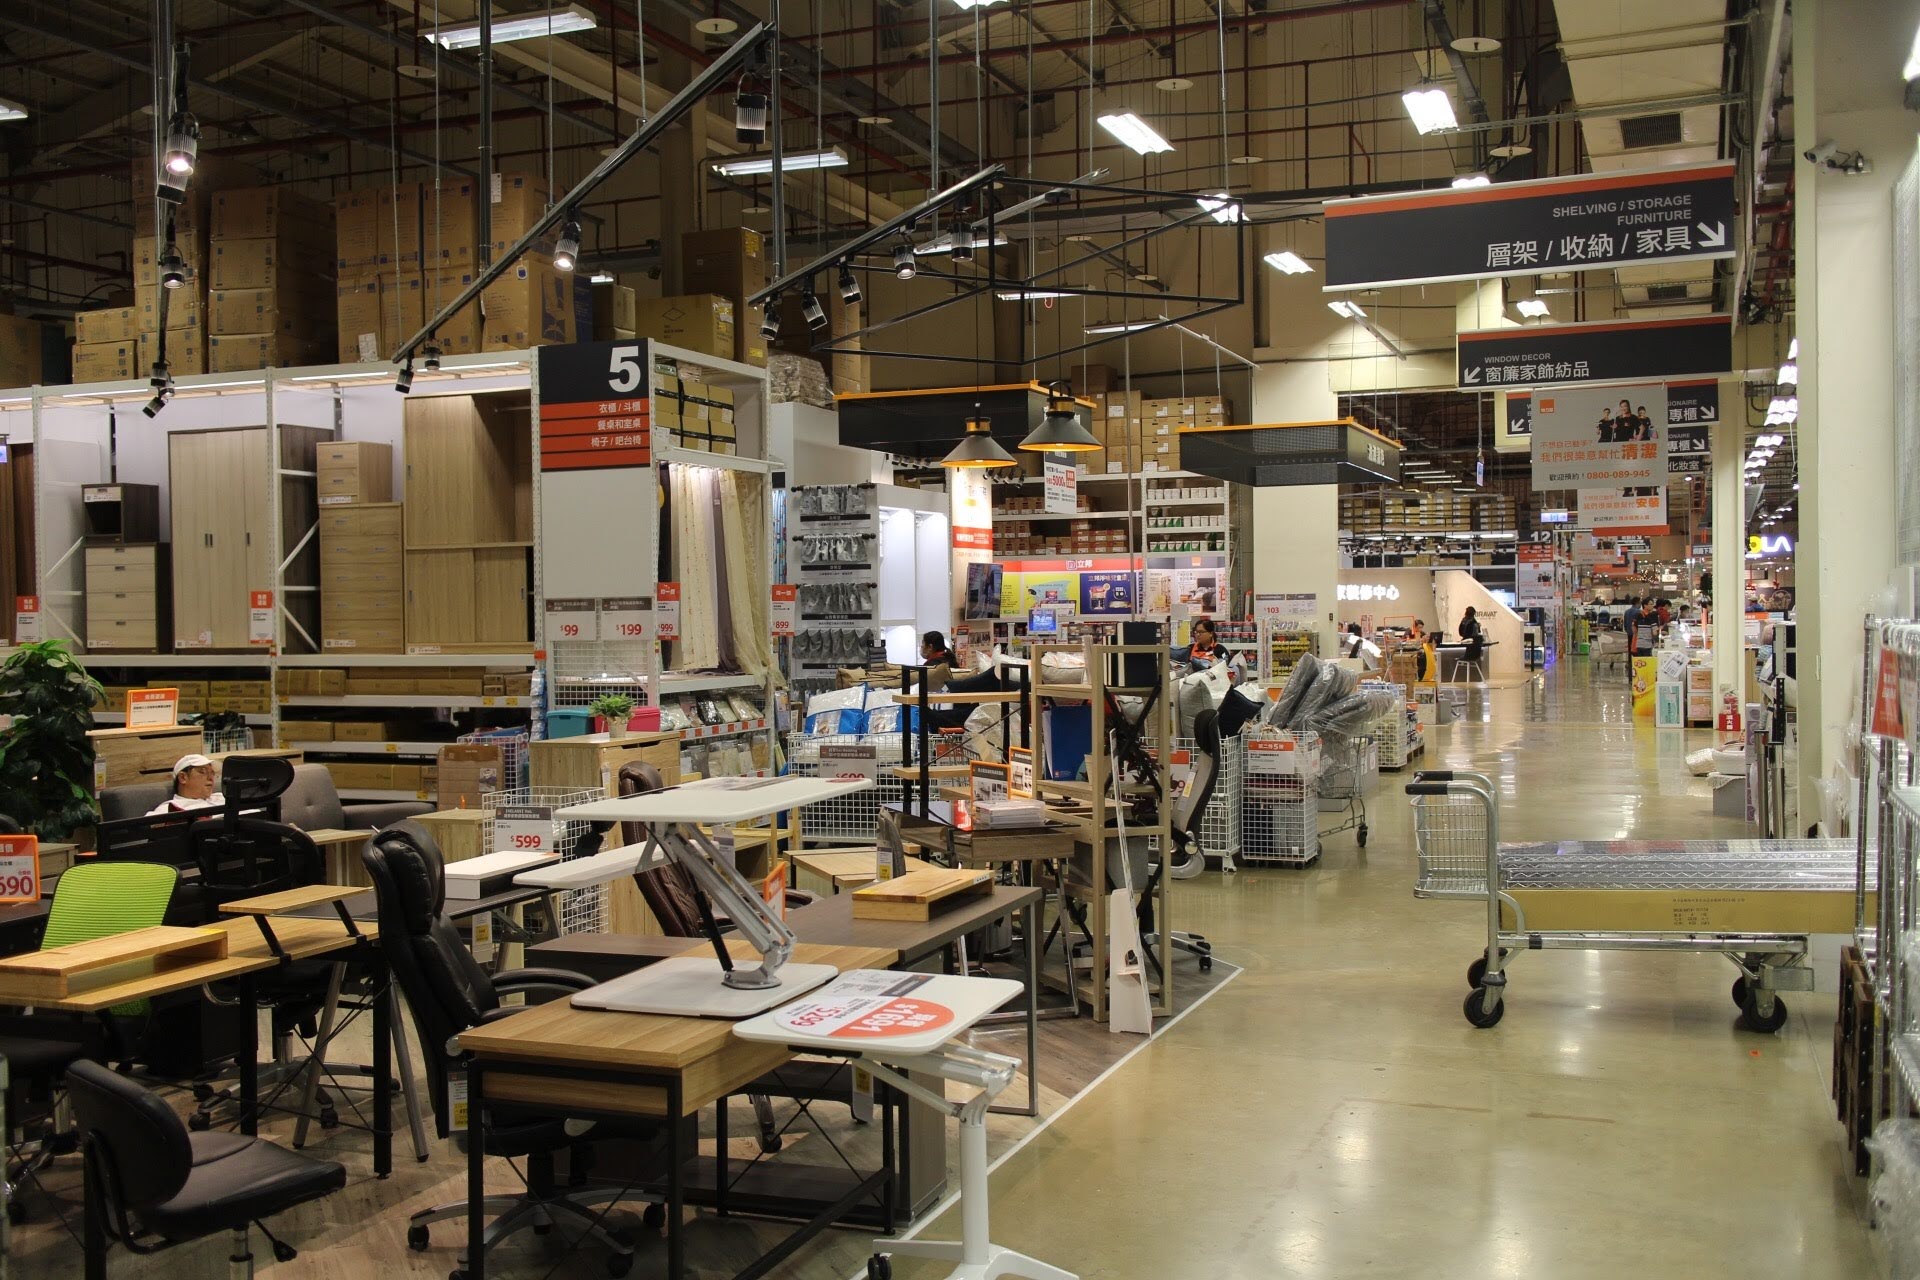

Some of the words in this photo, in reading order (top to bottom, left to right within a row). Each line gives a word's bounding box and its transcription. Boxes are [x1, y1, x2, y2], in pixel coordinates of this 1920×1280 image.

[1552, 200, 1617, 218] SHELVING
[1627, 194, 1692, 211] STORAGE
[1617, 209, 1692, 226] FURNITURE
[1486, 239, 1538, 268] 層架
[1545, 240, 1553, 262] /
[1560, 233, 1614, 261] 收納
[1621, 232, 1628, 254] /
[1636, 226, 1692, 252] 家具
[1484, 354, 1519, 364] WINDOW
[1521, 352, 1551, 362] DECOR
[608, 346, 641, 393] 5
[1485, 361, 1590, 383] 窗簾家飾紡品
[599, 402, 617, 413] 衣櫃
[623, 401, 641, 412] 斗櫃
[1668, 407, 1698, 422] 專櫃
[598, 418, 641, 431] 餐桌和室桌
[1668, 461, 1700, 471] 化妝室
[1587, 470, 1651, 480] 0800-089-945
[1531, 531, 1551, 543] 12
[560, 624, 578, 636] $99
[616, 623, 642, 636] $199
[510, 835, 541, 848] $599
[850, 1003, 920, 1032] $1691
